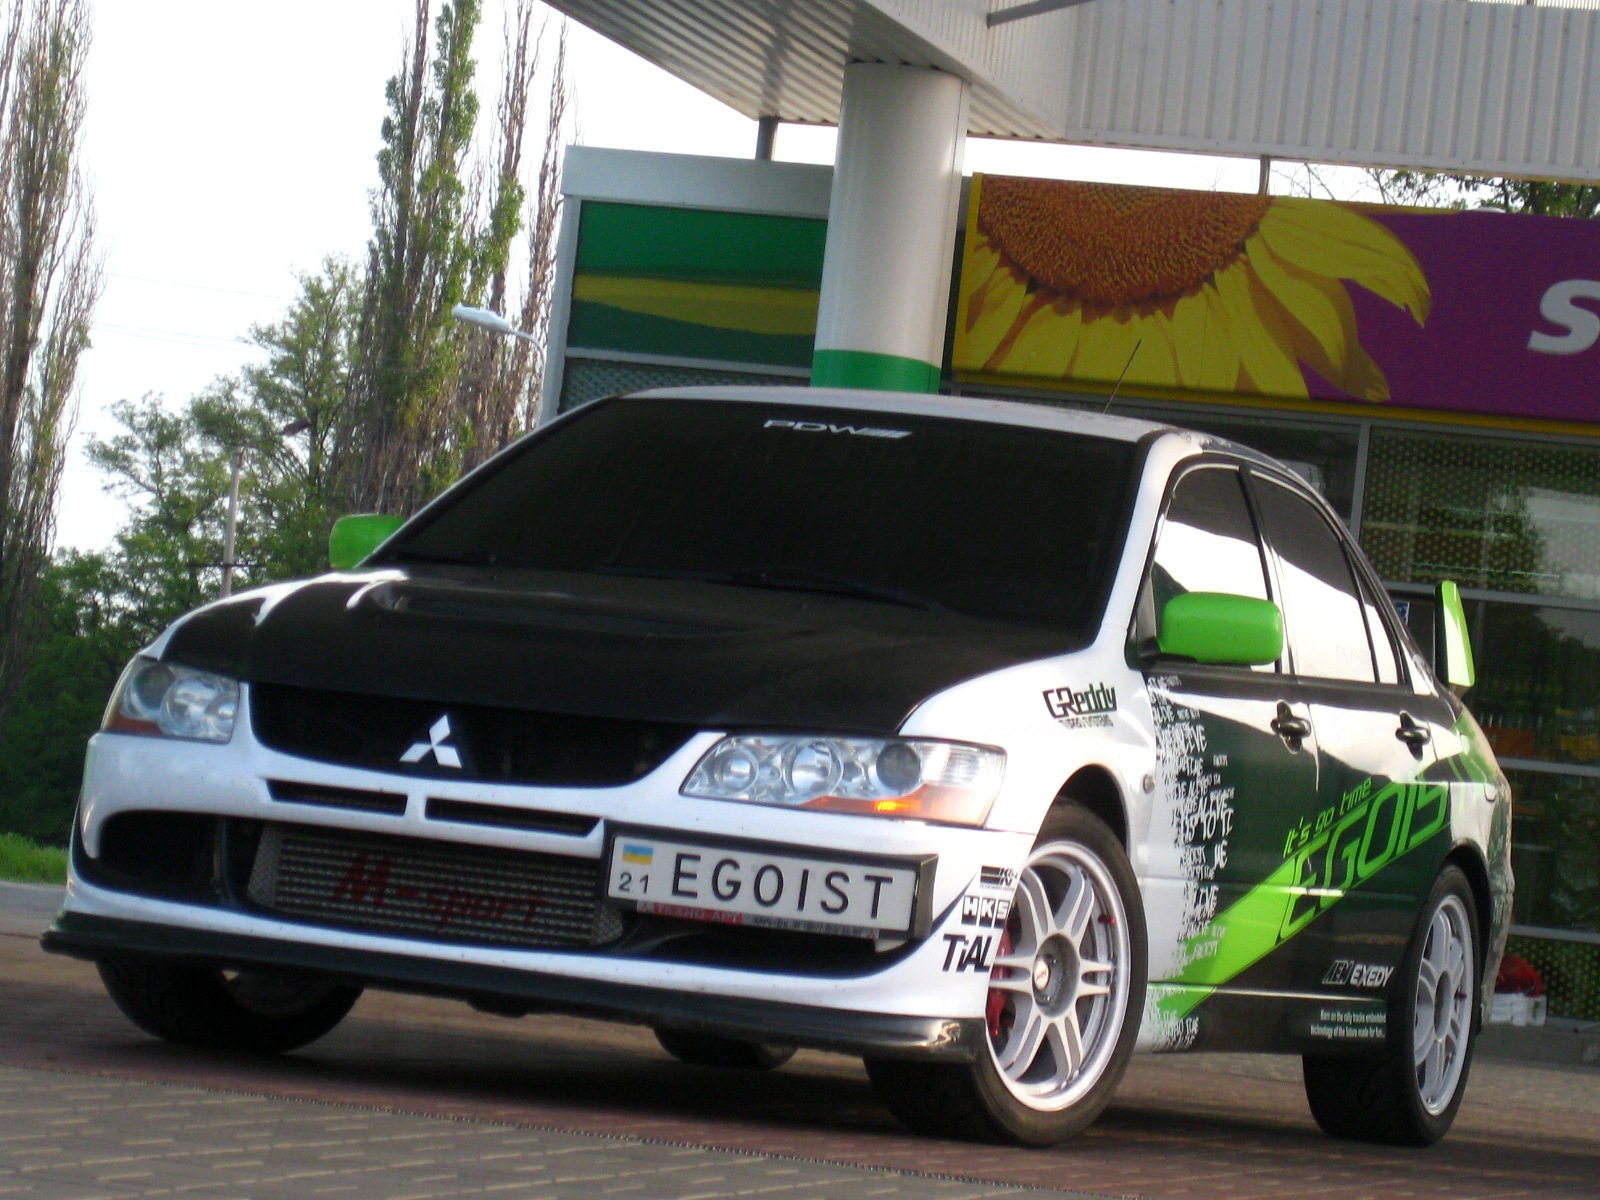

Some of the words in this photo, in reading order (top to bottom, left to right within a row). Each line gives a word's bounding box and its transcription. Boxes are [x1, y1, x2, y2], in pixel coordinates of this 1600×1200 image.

[1042, 682, 1118, 718] GReddy
[619, 871, 650, 894] 21
[671, 852, 894, 919] EGOIST
[961, 894, 1011, 929] HKS
[1350, 964, 1395, 988] EXEDY
